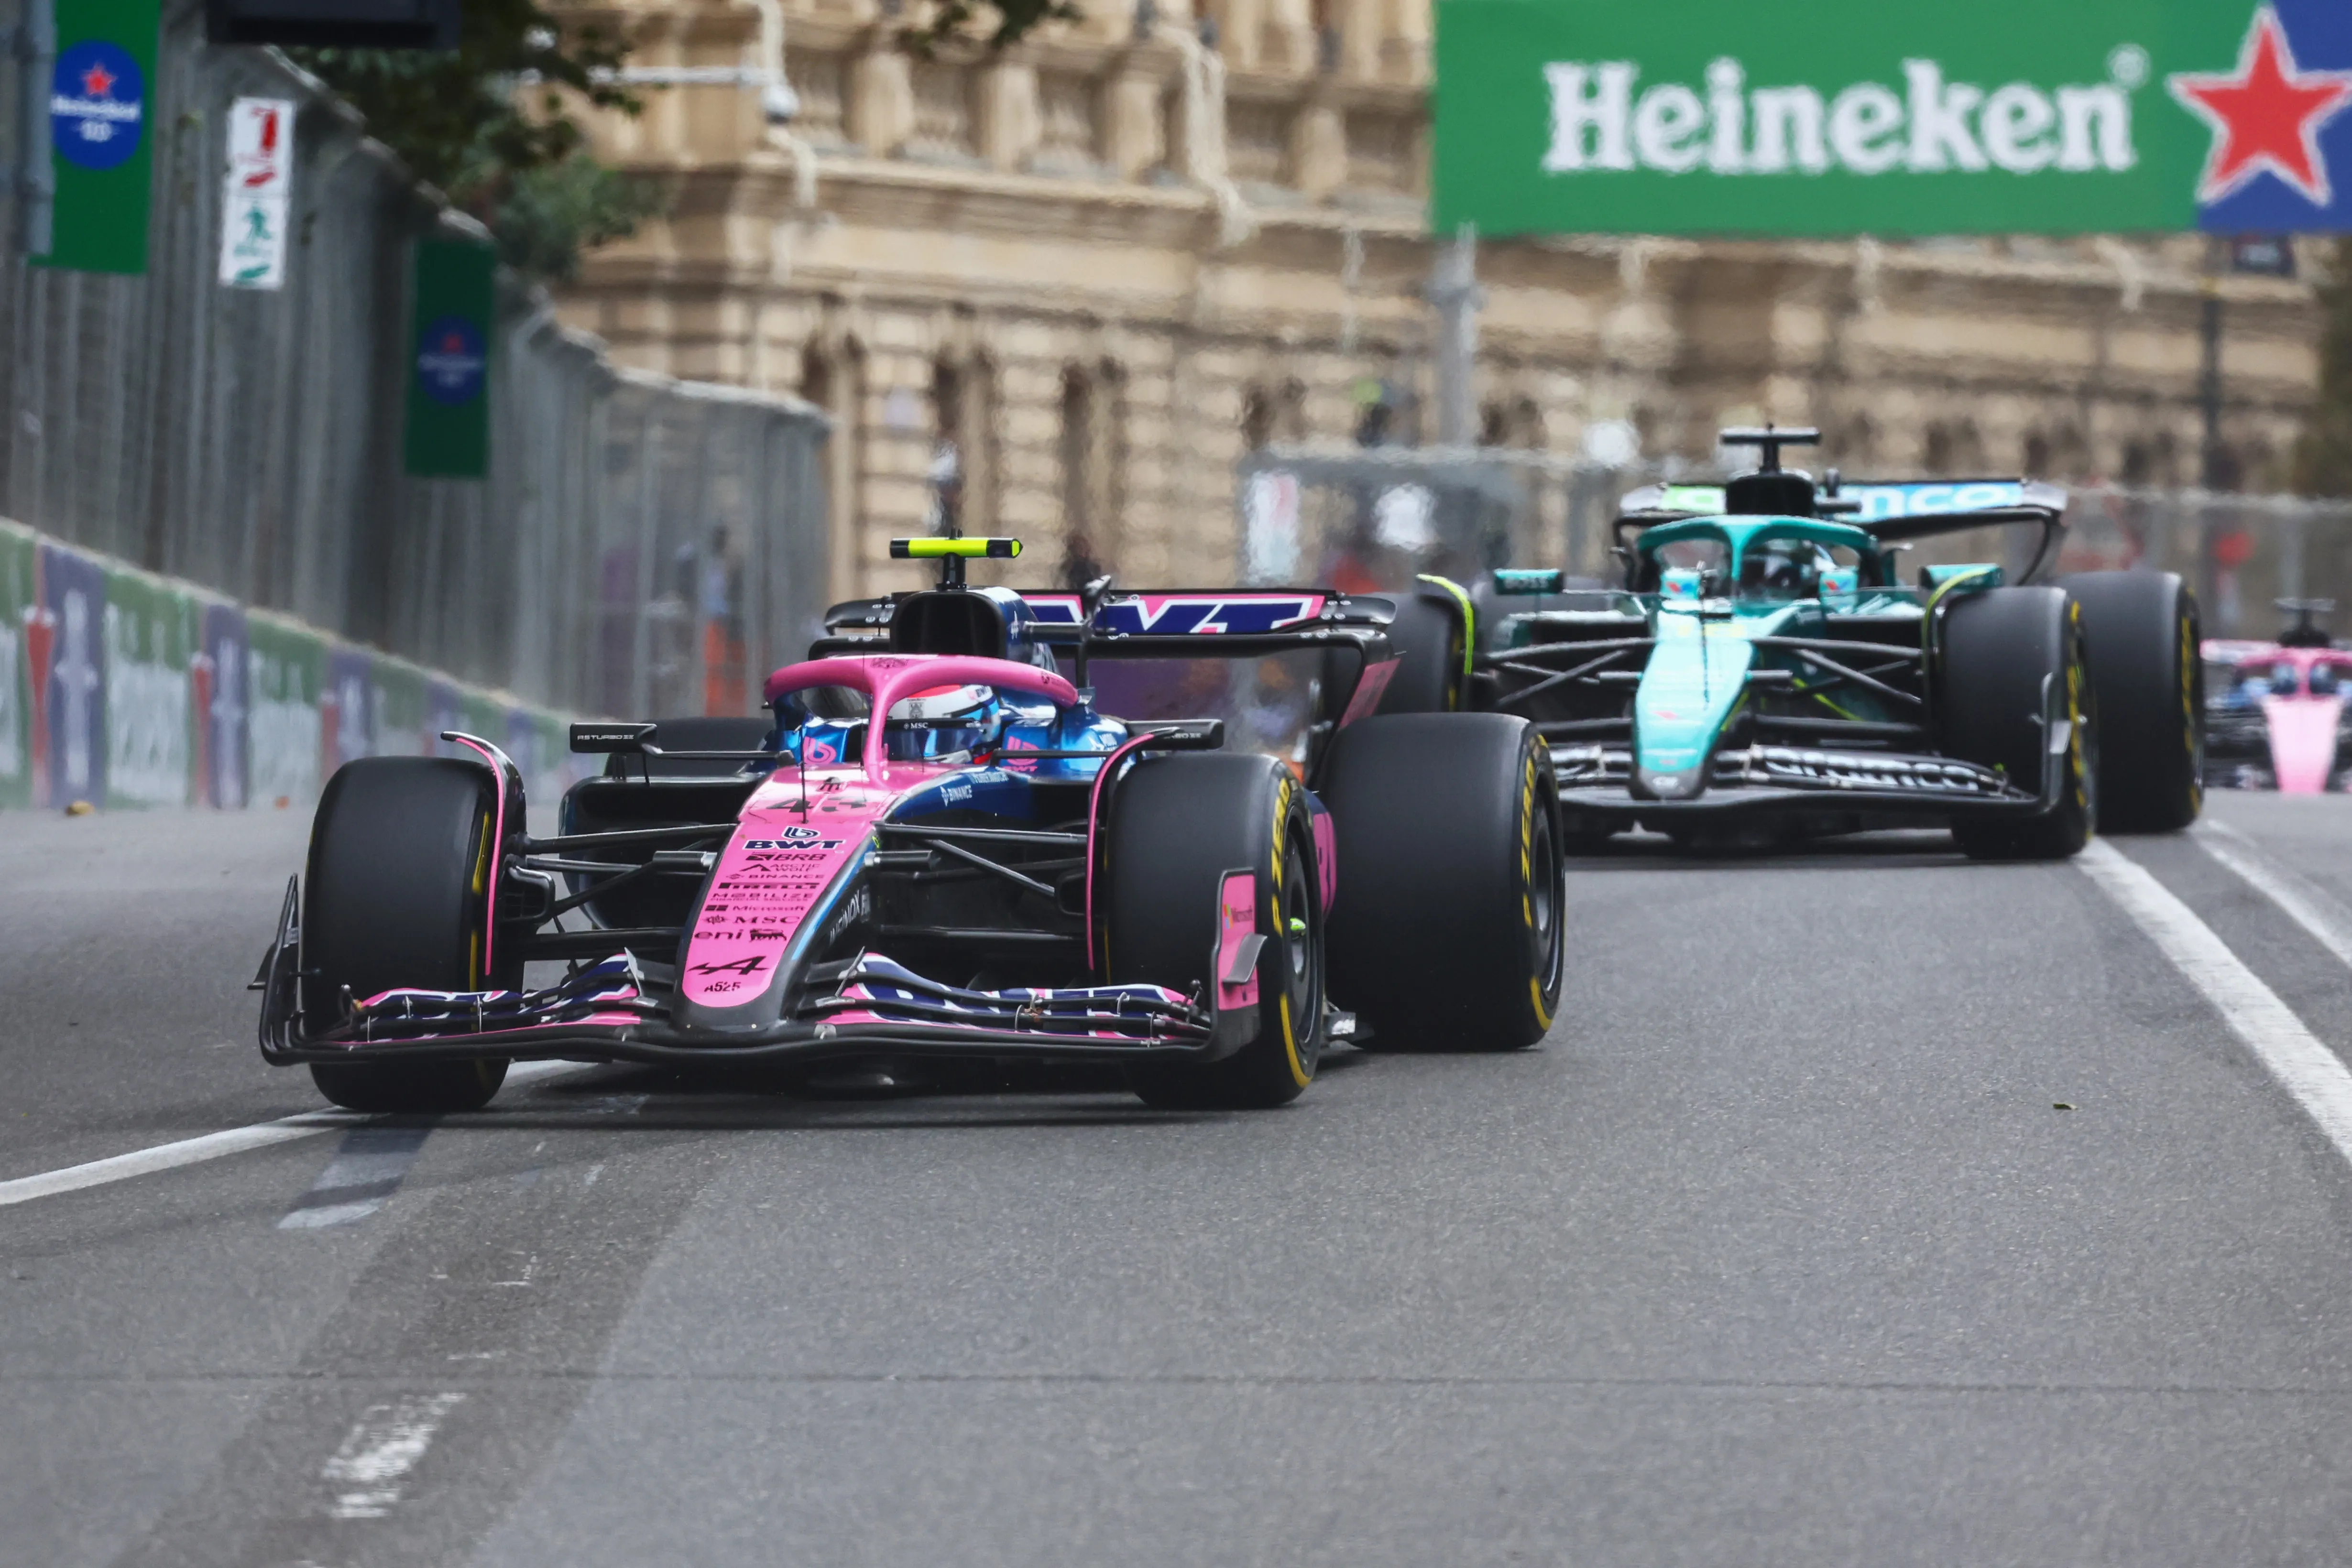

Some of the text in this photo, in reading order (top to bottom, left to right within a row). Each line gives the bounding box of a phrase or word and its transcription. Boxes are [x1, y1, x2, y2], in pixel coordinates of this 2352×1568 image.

[948, 784, 973, 802] BINANCE
[743, 840, 845, 849] BWT
[694, 929, 744, 940] eni
[704, 981, 742, 992] A525
